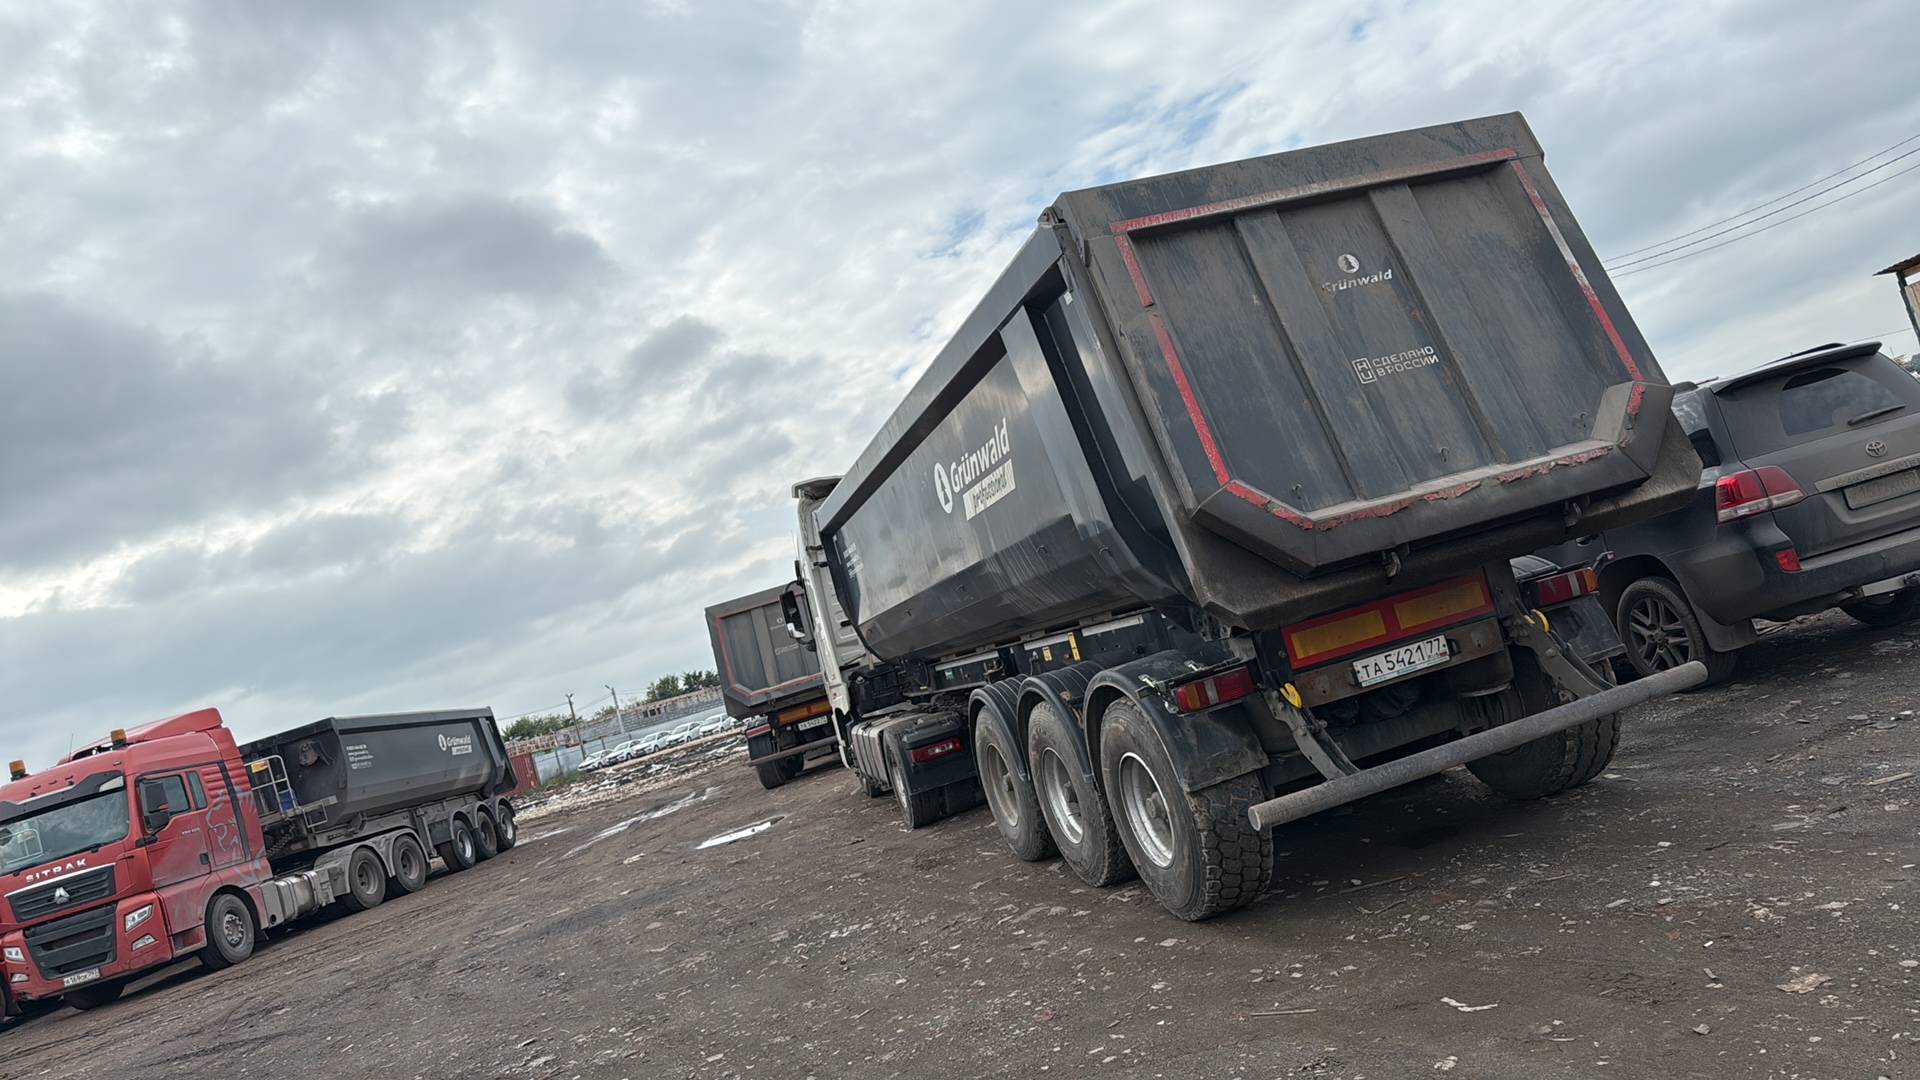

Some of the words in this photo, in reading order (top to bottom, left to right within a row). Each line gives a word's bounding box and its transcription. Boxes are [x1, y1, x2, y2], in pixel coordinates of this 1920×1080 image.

[1372, 345, 1434, 367] СДЕЛАНО
[1385, 355, 1440, 375] РОССИИ
[950, 417, 1011, 494] Grünwald
[25, 858, 87, 883] SITRAK
